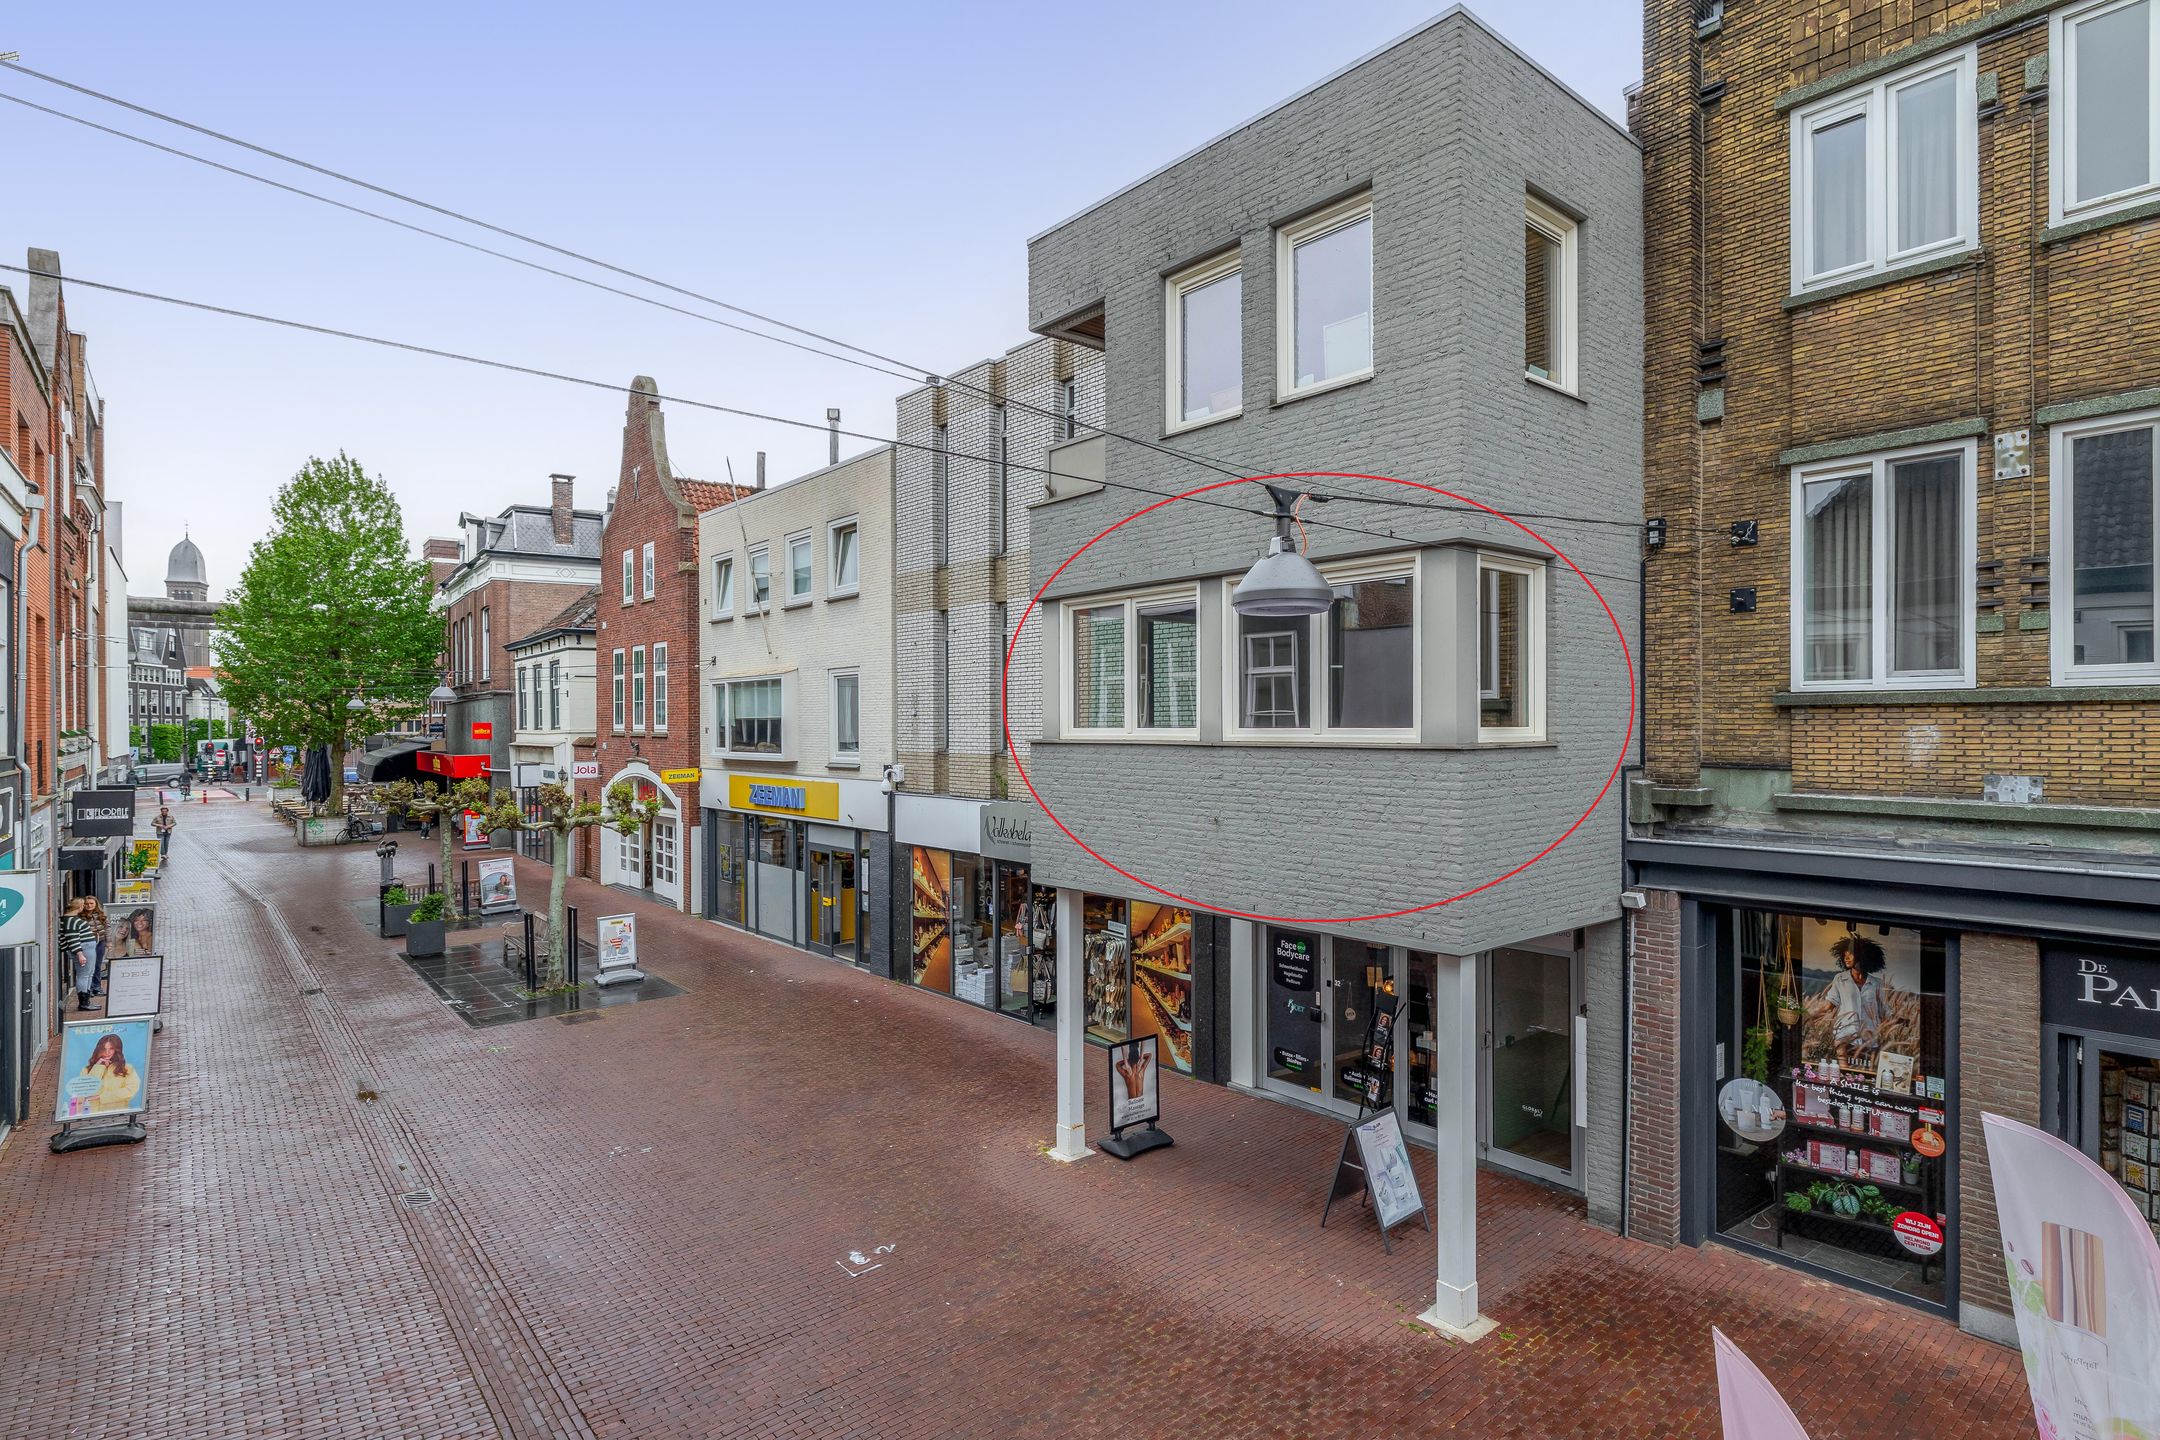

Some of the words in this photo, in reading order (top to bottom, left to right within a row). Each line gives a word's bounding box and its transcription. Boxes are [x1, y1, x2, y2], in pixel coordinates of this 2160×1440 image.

[574, 765, 597, 775] Jola
[668, 772, 695, 780] ZEEMAN
[749, 784, 805, 809] ZEEMAN
[94, 807, 129, 817] FLORALE
[1281, 940, 1297, 950] Face
[1277, 947, 1310, 961] Bodycare
[2078, 959, 2108, 974] DE
[1830, 1078, 1838, 1086] A
[1840, 1079, 1869, 1093] SMILE
[1872, 1087, 1881, 1096] is
[1794, 1079, 1809, 1089] the
[1811, 1084, 1827, 1094] best
[1829, 1088, 1851, 1102] thing
[1854, 1096, 1873, 1106] you
[1874, 1100, 1894, 1109] can
[1894, 1105, 1918, 1114] wear
[1817, 1096, 1846, 1109] besides
[1846, 1102, 1893, 1119] PERFUME
[1897, 1222, 1921, 1234] ZONDAG
[1921, 1229, 1939, 1239] OPEN!
[1916, 1221, 1932, 1230] ZIJN
[1904, 1235, 1931, 1247] HELMOND
